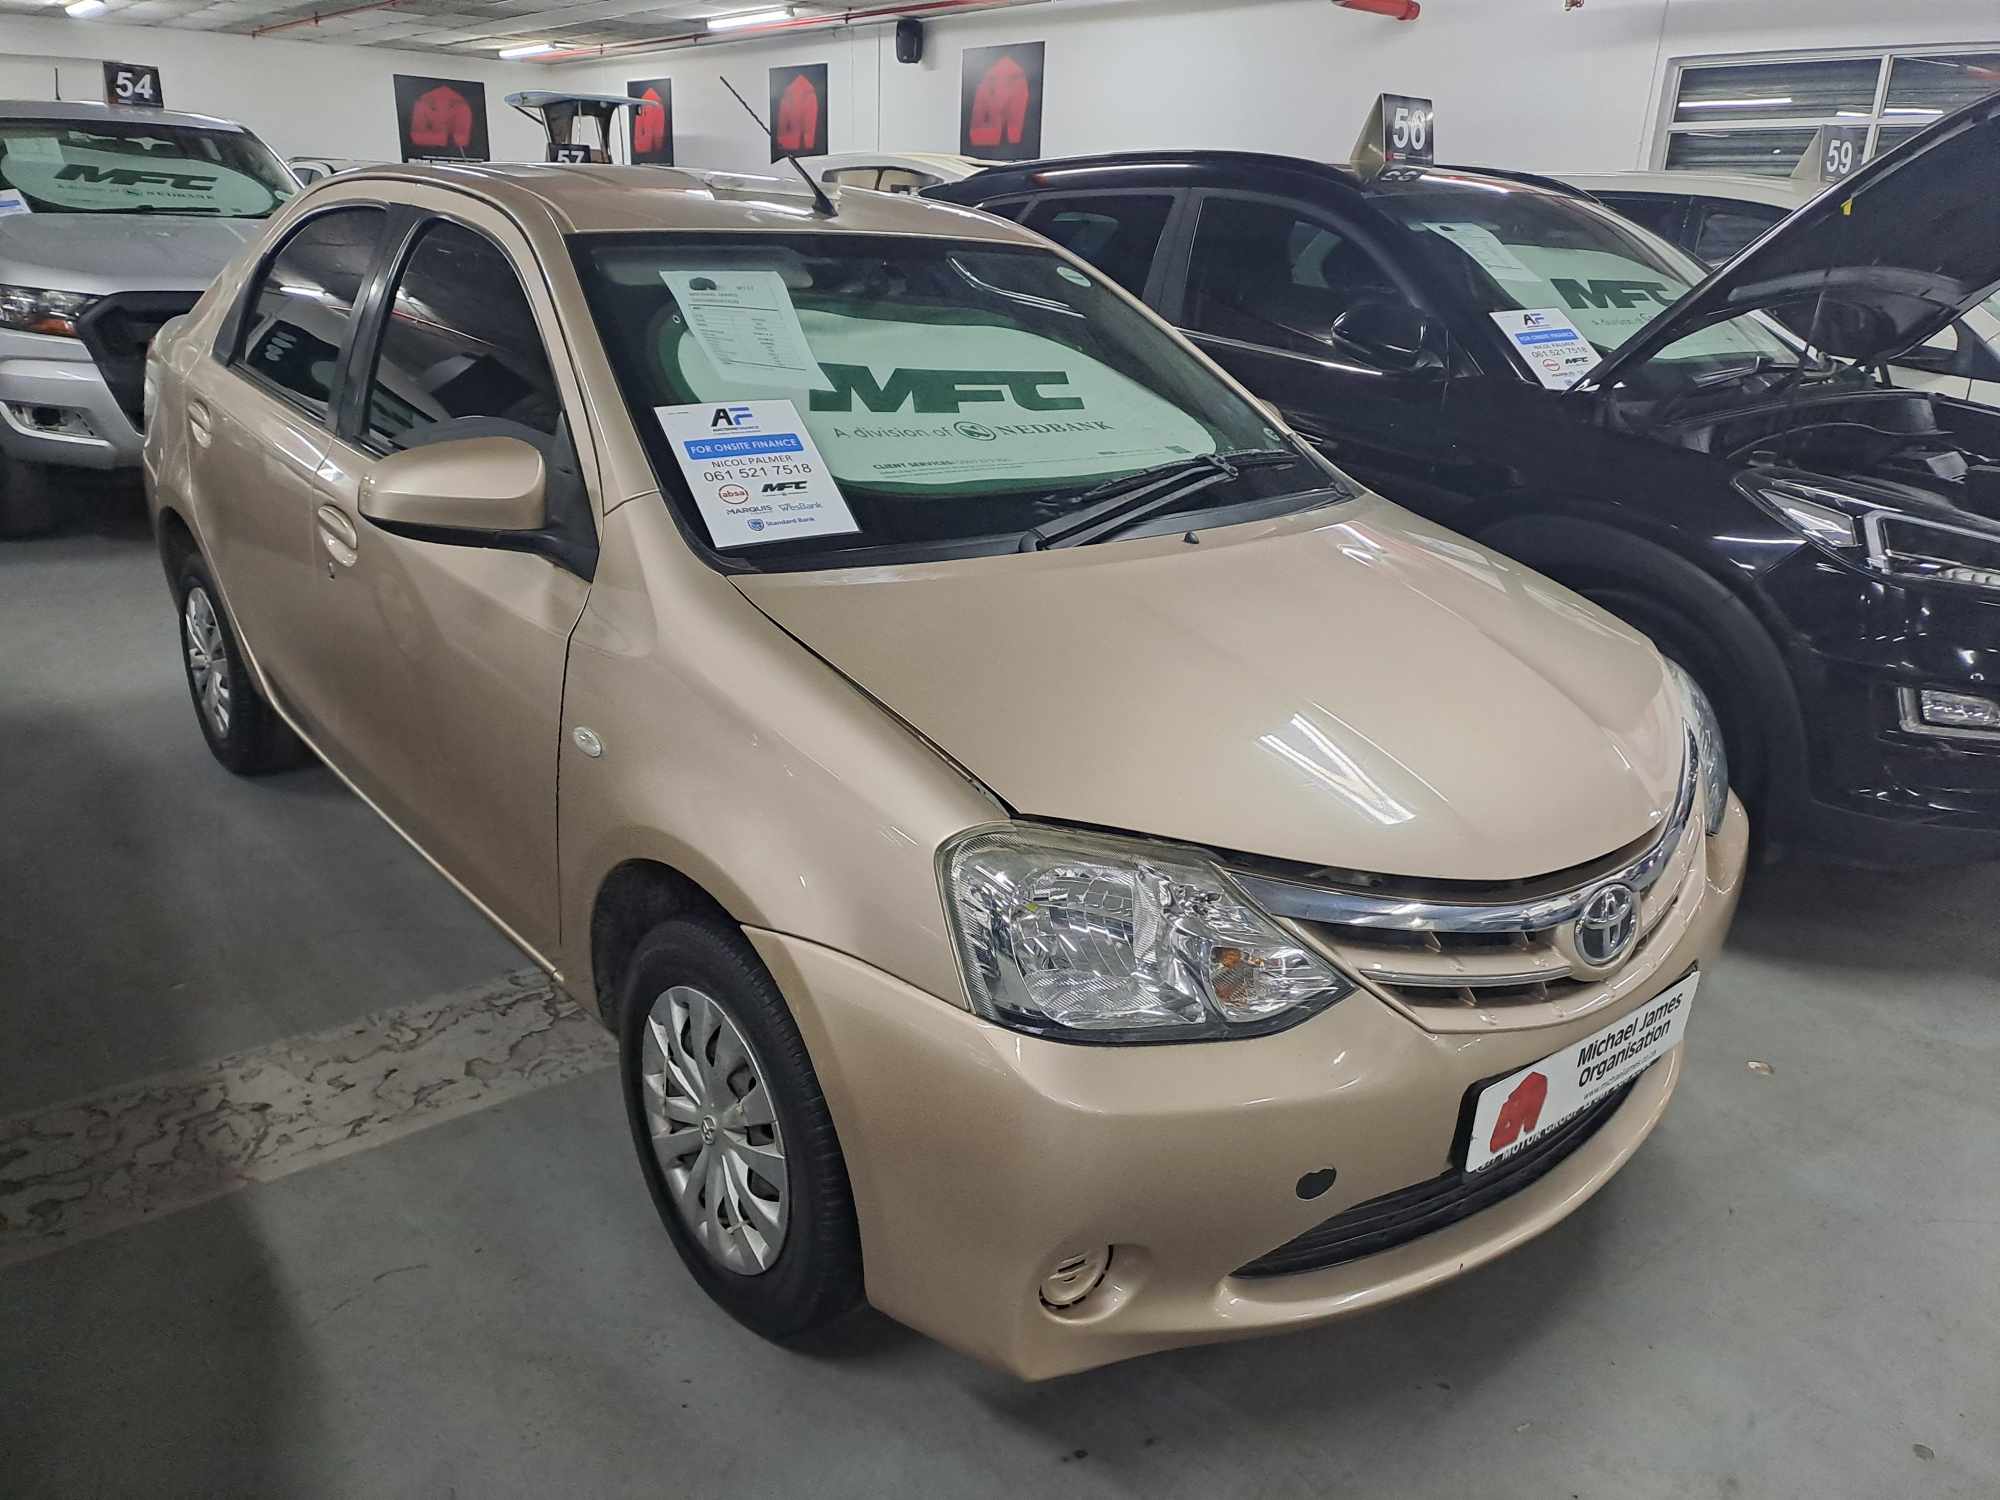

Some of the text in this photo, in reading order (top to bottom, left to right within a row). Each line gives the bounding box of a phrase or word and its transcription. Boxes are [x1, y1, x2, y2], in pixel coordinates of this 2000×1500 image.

[115, 72, 153, 98] 54
[557, 150, 585, 163] 57
[1827, 140, 1852, 174] 59
[53, 164, 219, 191] MFC
[809, 362, 1085, 414] MFC
[710, 406, 753, 427] AF
[833, 420, 1114, 440] A division of NEDBANK
[690, 438, 798, 455] FOR ONSITE FINANCE
[711, 455, 793, 468] NICOL PALMER
[704, 463, 812, 482] 061 521 7518
[721, 480, 809, 498] absa MFC
[726, 504, 773, 516] MARQUIS
[1577, 992, 1683, 1069] Michael James
[1578, 1019, 1672, 1088] Organisation
